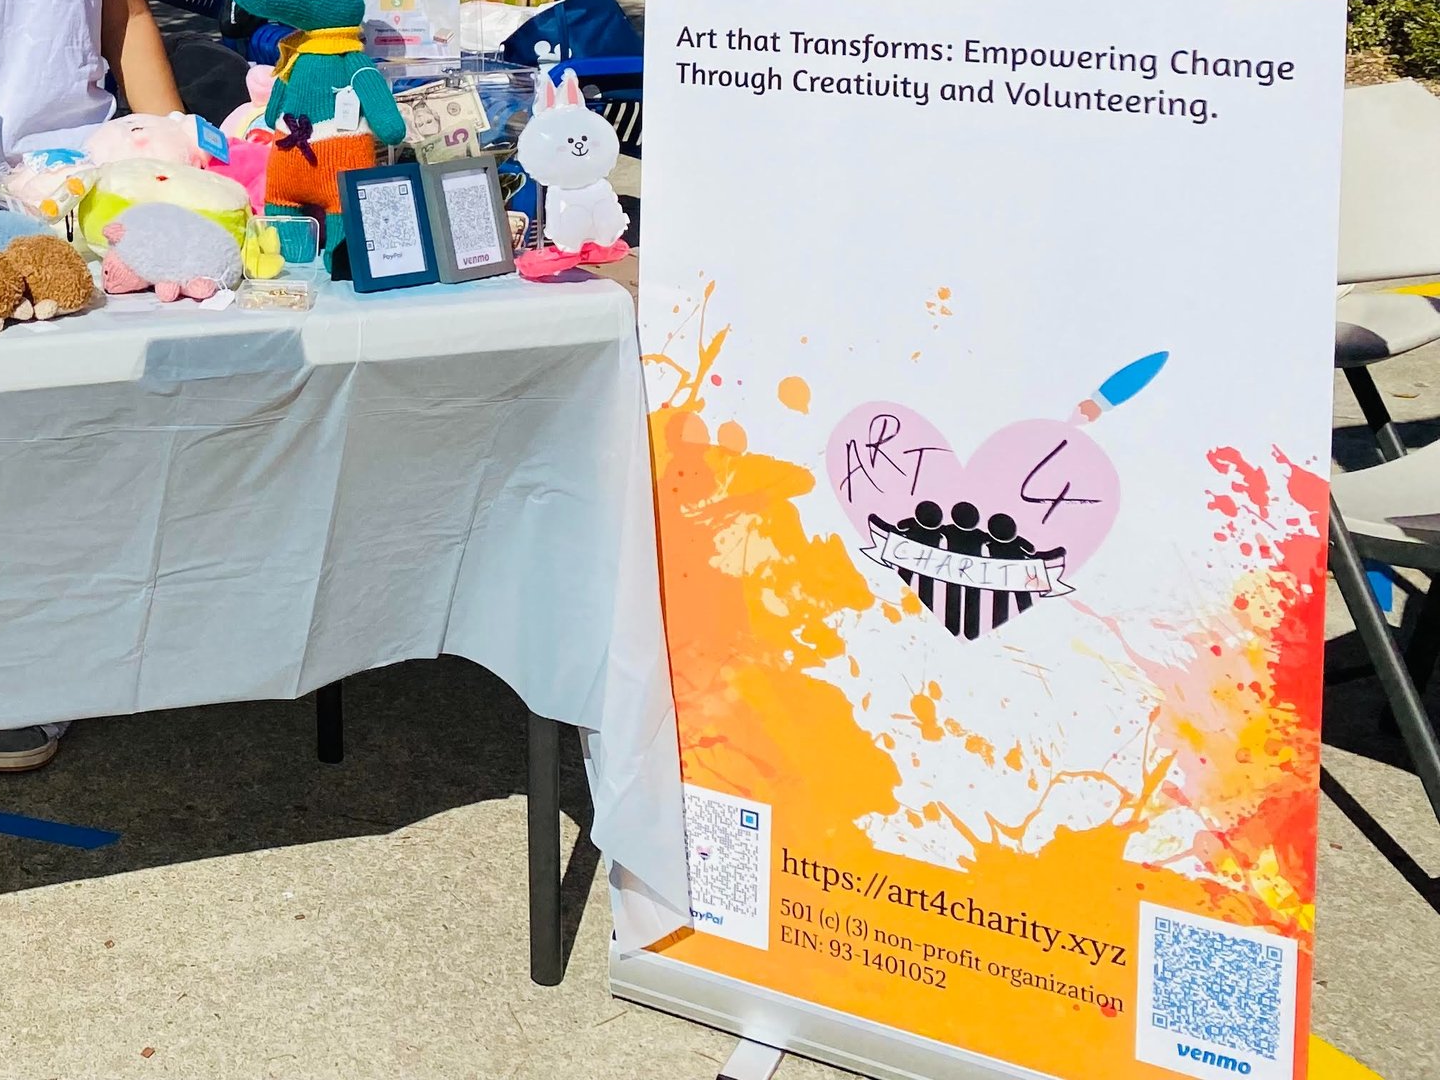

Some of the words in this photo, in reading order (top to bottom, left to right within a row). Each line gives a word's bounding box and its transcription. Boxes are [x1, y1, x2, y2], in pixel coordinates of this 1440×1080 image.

[676, 26, 717, 49] Art
[726, 28, 781, 52] that
[790, 32, 953, 63] Transforms:
[965, 39, 1158, 80] Empowering
[1171, 49, 1295, 86] Change
[676, 62, 782, 95] Through
[793, 70, 929, 105] Creativity
[940, 80, 994, 103] and
[1006, 81, 1219, 125] Volunteering.
[444, 128, 469, 147] 5
[840, 414, 954, 503] ART
[1020, 439, 1102, 524] 4
[892, 540, 1041, 589] CHARITY
[689, 907, 724, 925] ayPal
[781, 848, 1127, 967] https://art4charity.xyz
[780, 898, 813, 923] 501
[819, 908, 840, 933] (c)
[845, 915, 868, 941] (3)
[874, 928, 982, 972] non-profit
[987, 961, 1125, 1013] organization
[780, 924, 824, 954] EIN:
[829, 939, 947, 989] 93-1401052
[1177, 1043, 1252, 1075] venmo
